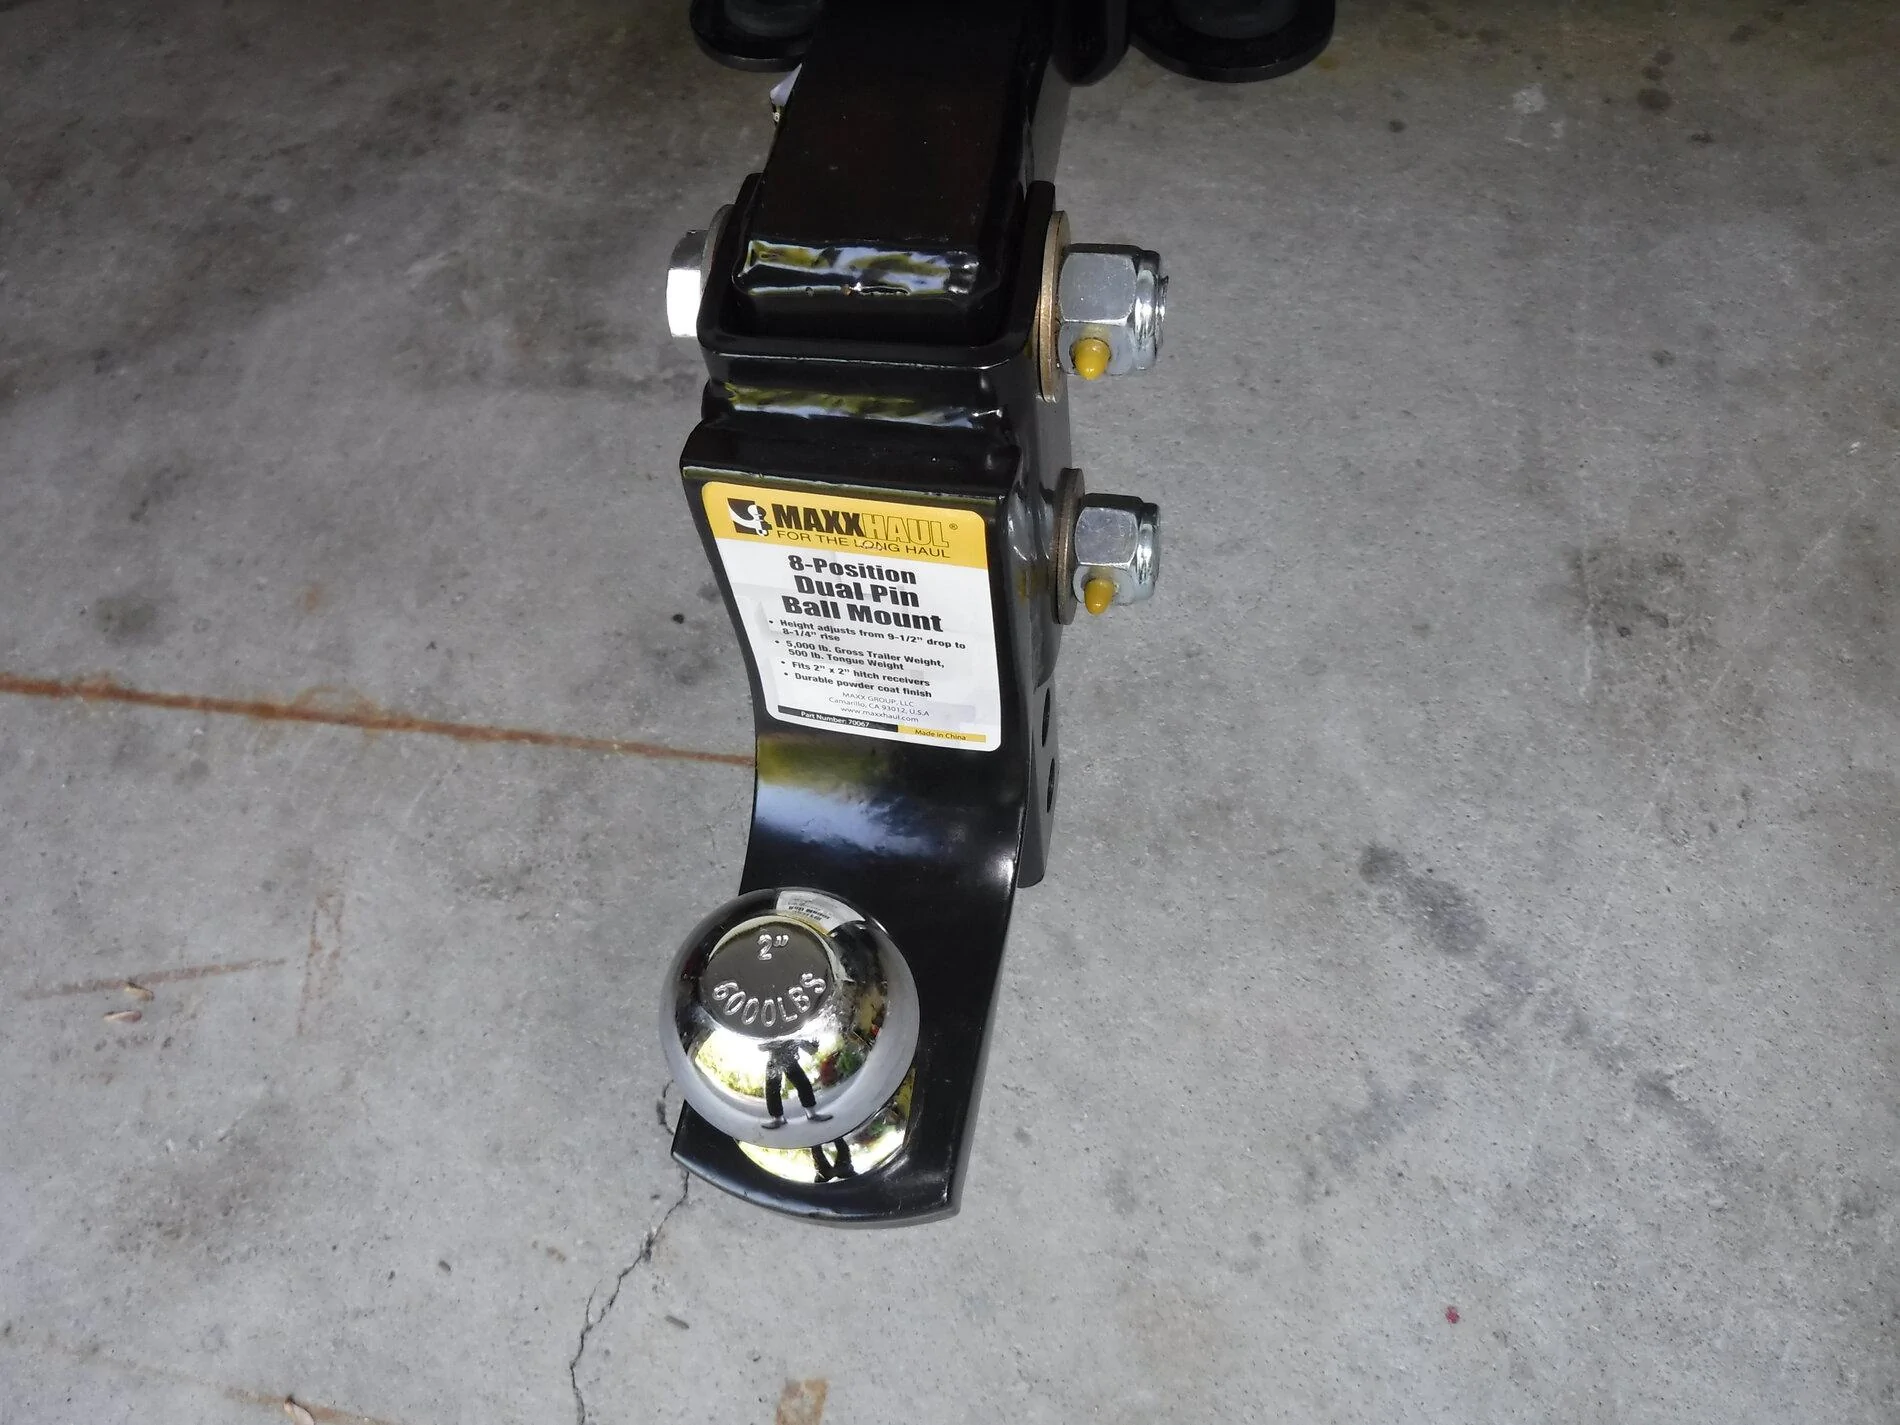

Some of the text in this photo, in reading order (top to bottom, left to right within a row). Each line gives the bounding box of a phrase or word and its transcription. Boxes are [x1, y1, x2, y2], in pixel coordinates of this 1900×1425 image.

[777, 530, 951, 559] FOR THE LONG HAUL
[788, 554, 917, 585] 8-Position
[794, 575, 920, 608] Dual Pin
[781, 595, 944, 632] Ball Mount
[780, 619, 814, 630] Height
[817, 624, 856, 635] adjusts
[860, 629, 885, 639] from
[927, 639, 952, 648] drop
[820, 633, 841, 641] rise
[786, 640, 944, 668] 5,000 lb. Gross Trailer Weight,
[788, 649, 904, 670] 500 lb. Tongue Weight
[792, 661, 811, 670] Fits
[853, 670, 880, 679] hitch
[882, 674, 931, 686] receivers
[795, 672, 932, 698] Durable powder coat finish
[800, 711, 815, 719] Part
[841, 707, 919, 723] www.maxxhaul.com
[914, 729, 935, 738] Made
[945, 732, 967, 741] China
